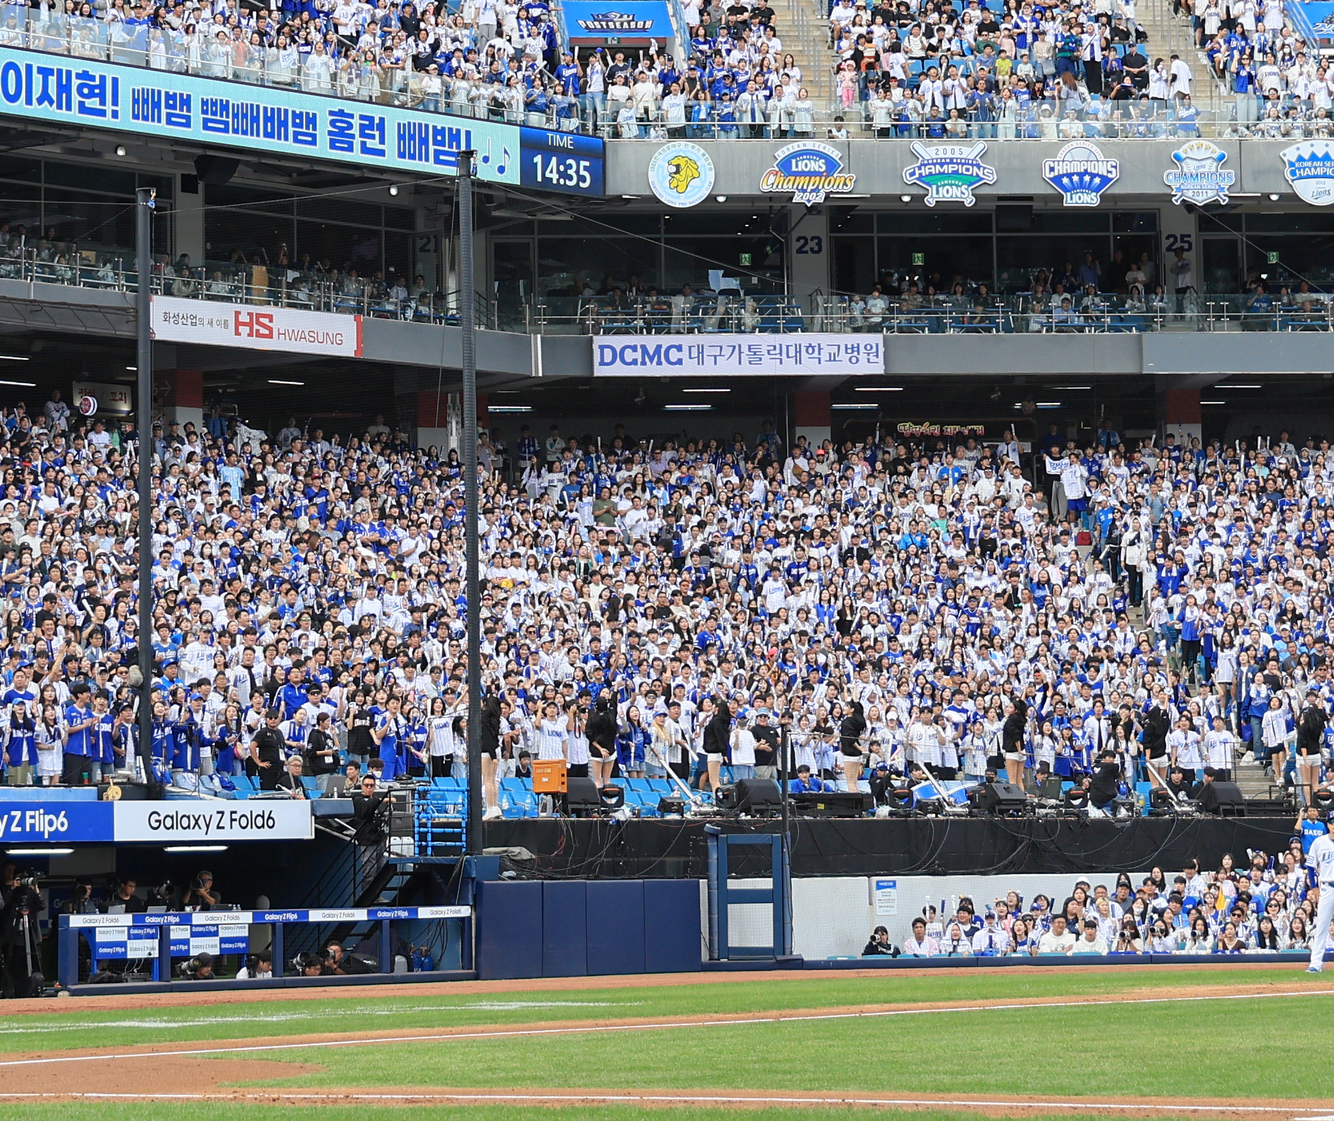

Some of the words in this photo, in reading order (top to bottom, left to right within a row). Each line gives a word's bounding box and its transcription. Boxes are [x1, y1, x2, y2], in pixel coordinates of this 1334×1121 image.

[576, 20, 654, 29] POSTSEASON
[0, 61, 119, 120] 이재현!
[131, 87, 192, 129] 빼뱀
[328, 109, 386, 158] 홈런
[547, 133, 574, 149] TIME
[777, 143, 808, 158] KOREAN
[812, 143, 841, 158] SERIES
[533, 154, 592, 189] 14:35
[791, 158, 826, 172] LIONS
[905, 162, 994, 178] CHAMPIONS
[1045, 161, 1117, 177] CHAMPIONS
[762, 170, 855, 192] Champions
[1166, 172, 1233, 183] CHAMPIONS
[795, 192, 823, 201] 2002
[932, 184, 968, 198] LIONS
[1066, 192, 1097, 204] LIONS
[1311, 189, 1331, 199] Lions
[796, 236, 823, 254] 23
[1165, 234, 1193, 252] 25
[207, 318, 214, 327] 새
[216, 320, 229, 330] 이름
[234, 310, 274, 340] HS
[277, 329, 344, 346] HWASUNG
[598, 344, 684, 367] DCMC
[688, 342, 880, 365] 대구가톨릭대학교병원
[12, 813, 22, 832] Z
[26, 809, 68, 839] Flip6
[148, 811, 214, 837] Galaxy
[217, 811, 226, 829] Z
[230, 809, 276, 830] Fold6
